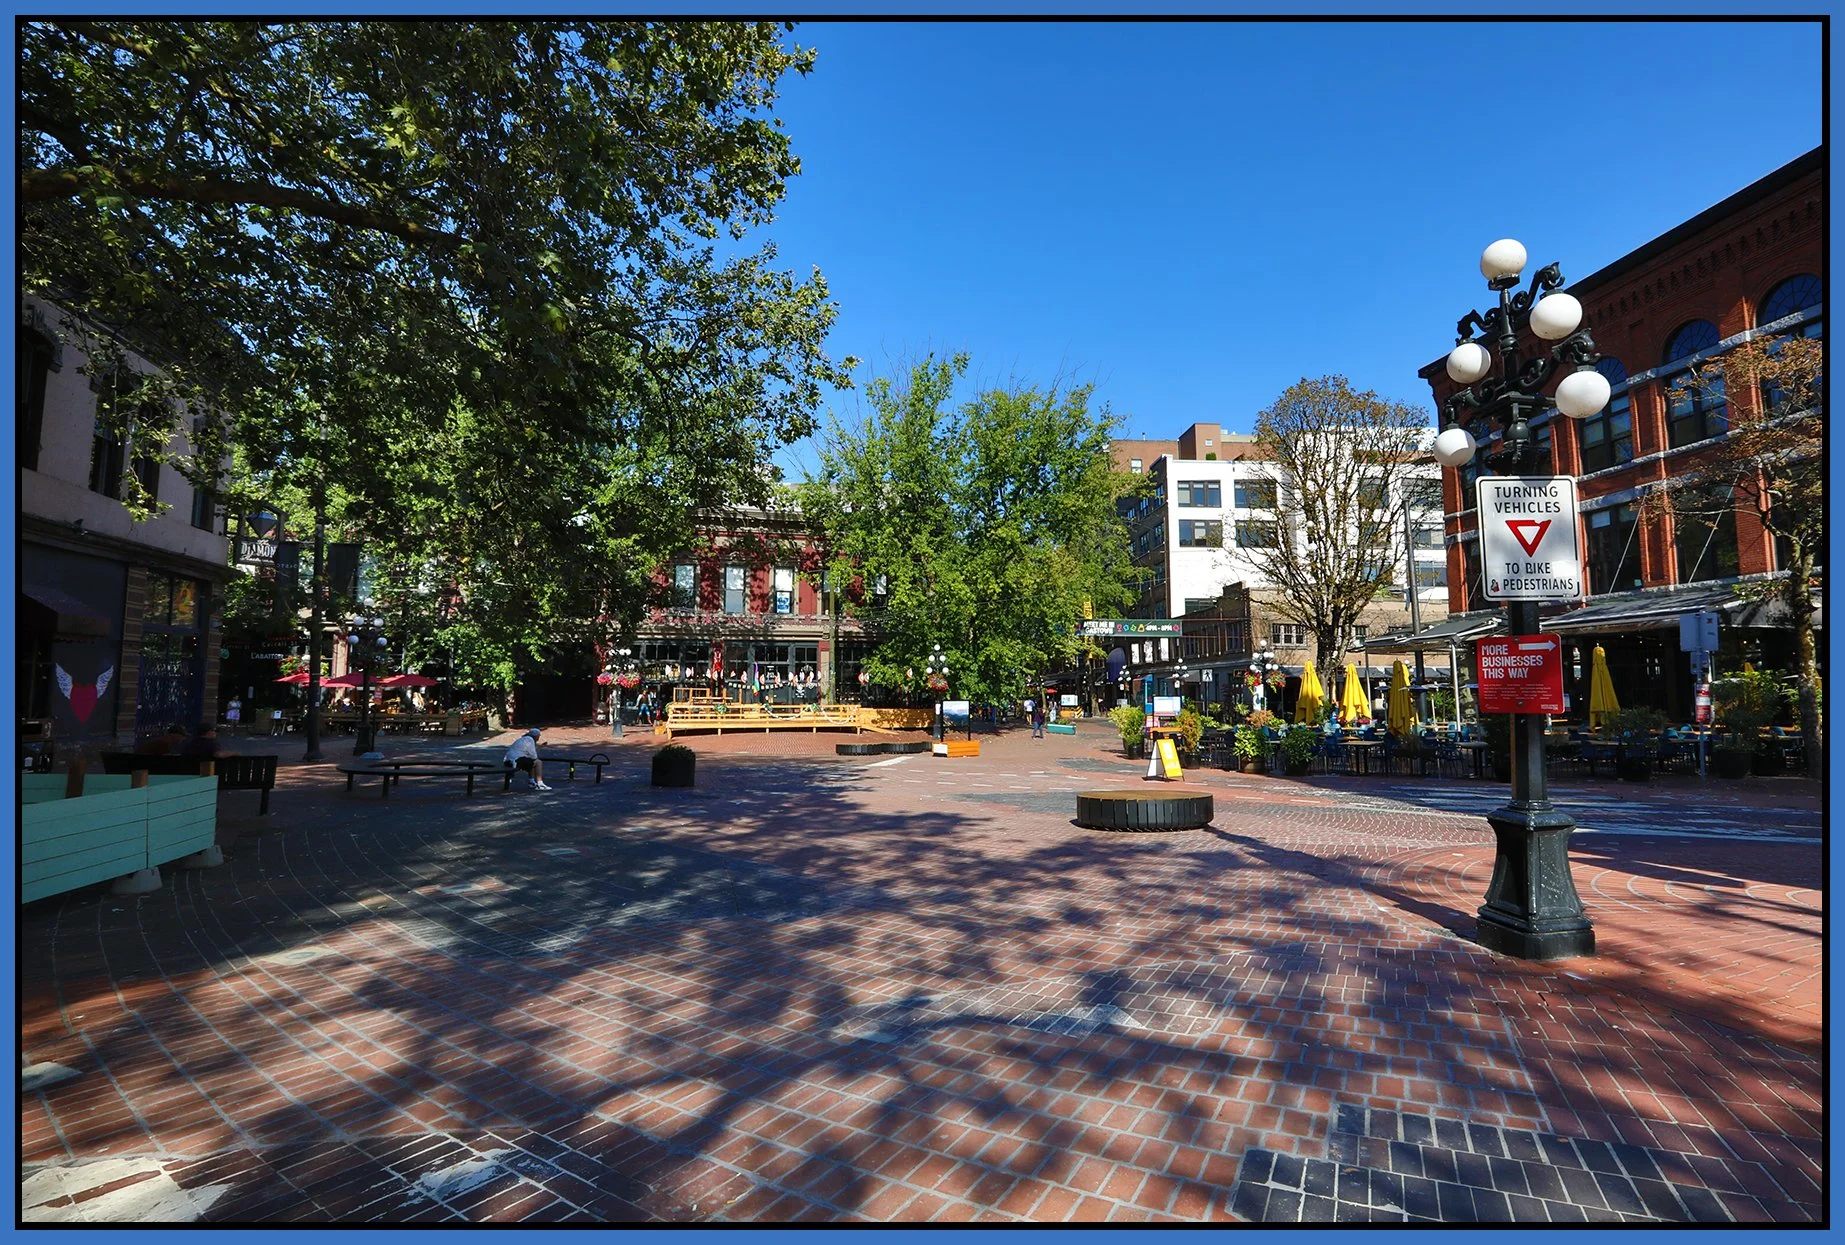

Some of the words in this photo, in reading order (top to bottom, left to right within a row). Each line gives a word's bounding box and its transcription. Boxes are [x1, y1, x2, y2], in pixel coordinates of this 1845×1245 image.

[1494, 486, 1559, 498] TURNING
[1494, 501, 1561, 513] VEHICLES
[241, 542, 279, 558] DIAMON
[1505, 562, 1520, 575] TO
[1525, 562, 1551, 574] BIKE
[1503, 578, 1574, 591] PEDESTRIANS
[1481, 644, 1509, 656] MORE
[1482, 655, 1543, 668] BUSINESSES
[1482, 668, 1505, 679] THIS
[1508, 667, 1529, 679] WAY
